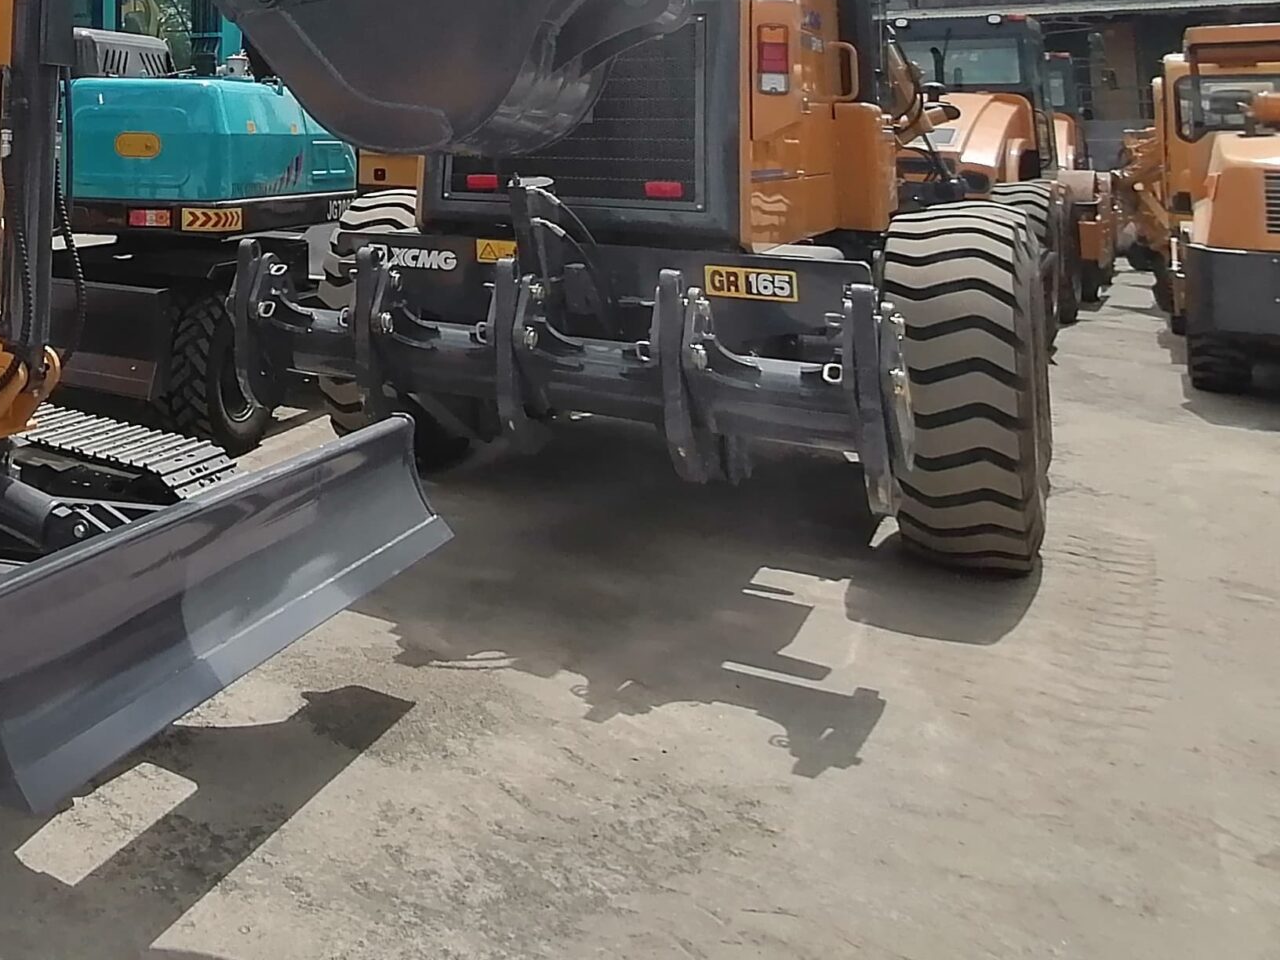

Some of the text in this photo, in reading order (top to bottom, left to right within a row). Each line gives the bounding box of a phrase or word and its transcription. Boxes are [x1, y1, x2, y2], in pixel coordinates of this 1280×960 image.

[389, 246, 457, 271] XCMG
[709, 269, 791, 297] GR 165
